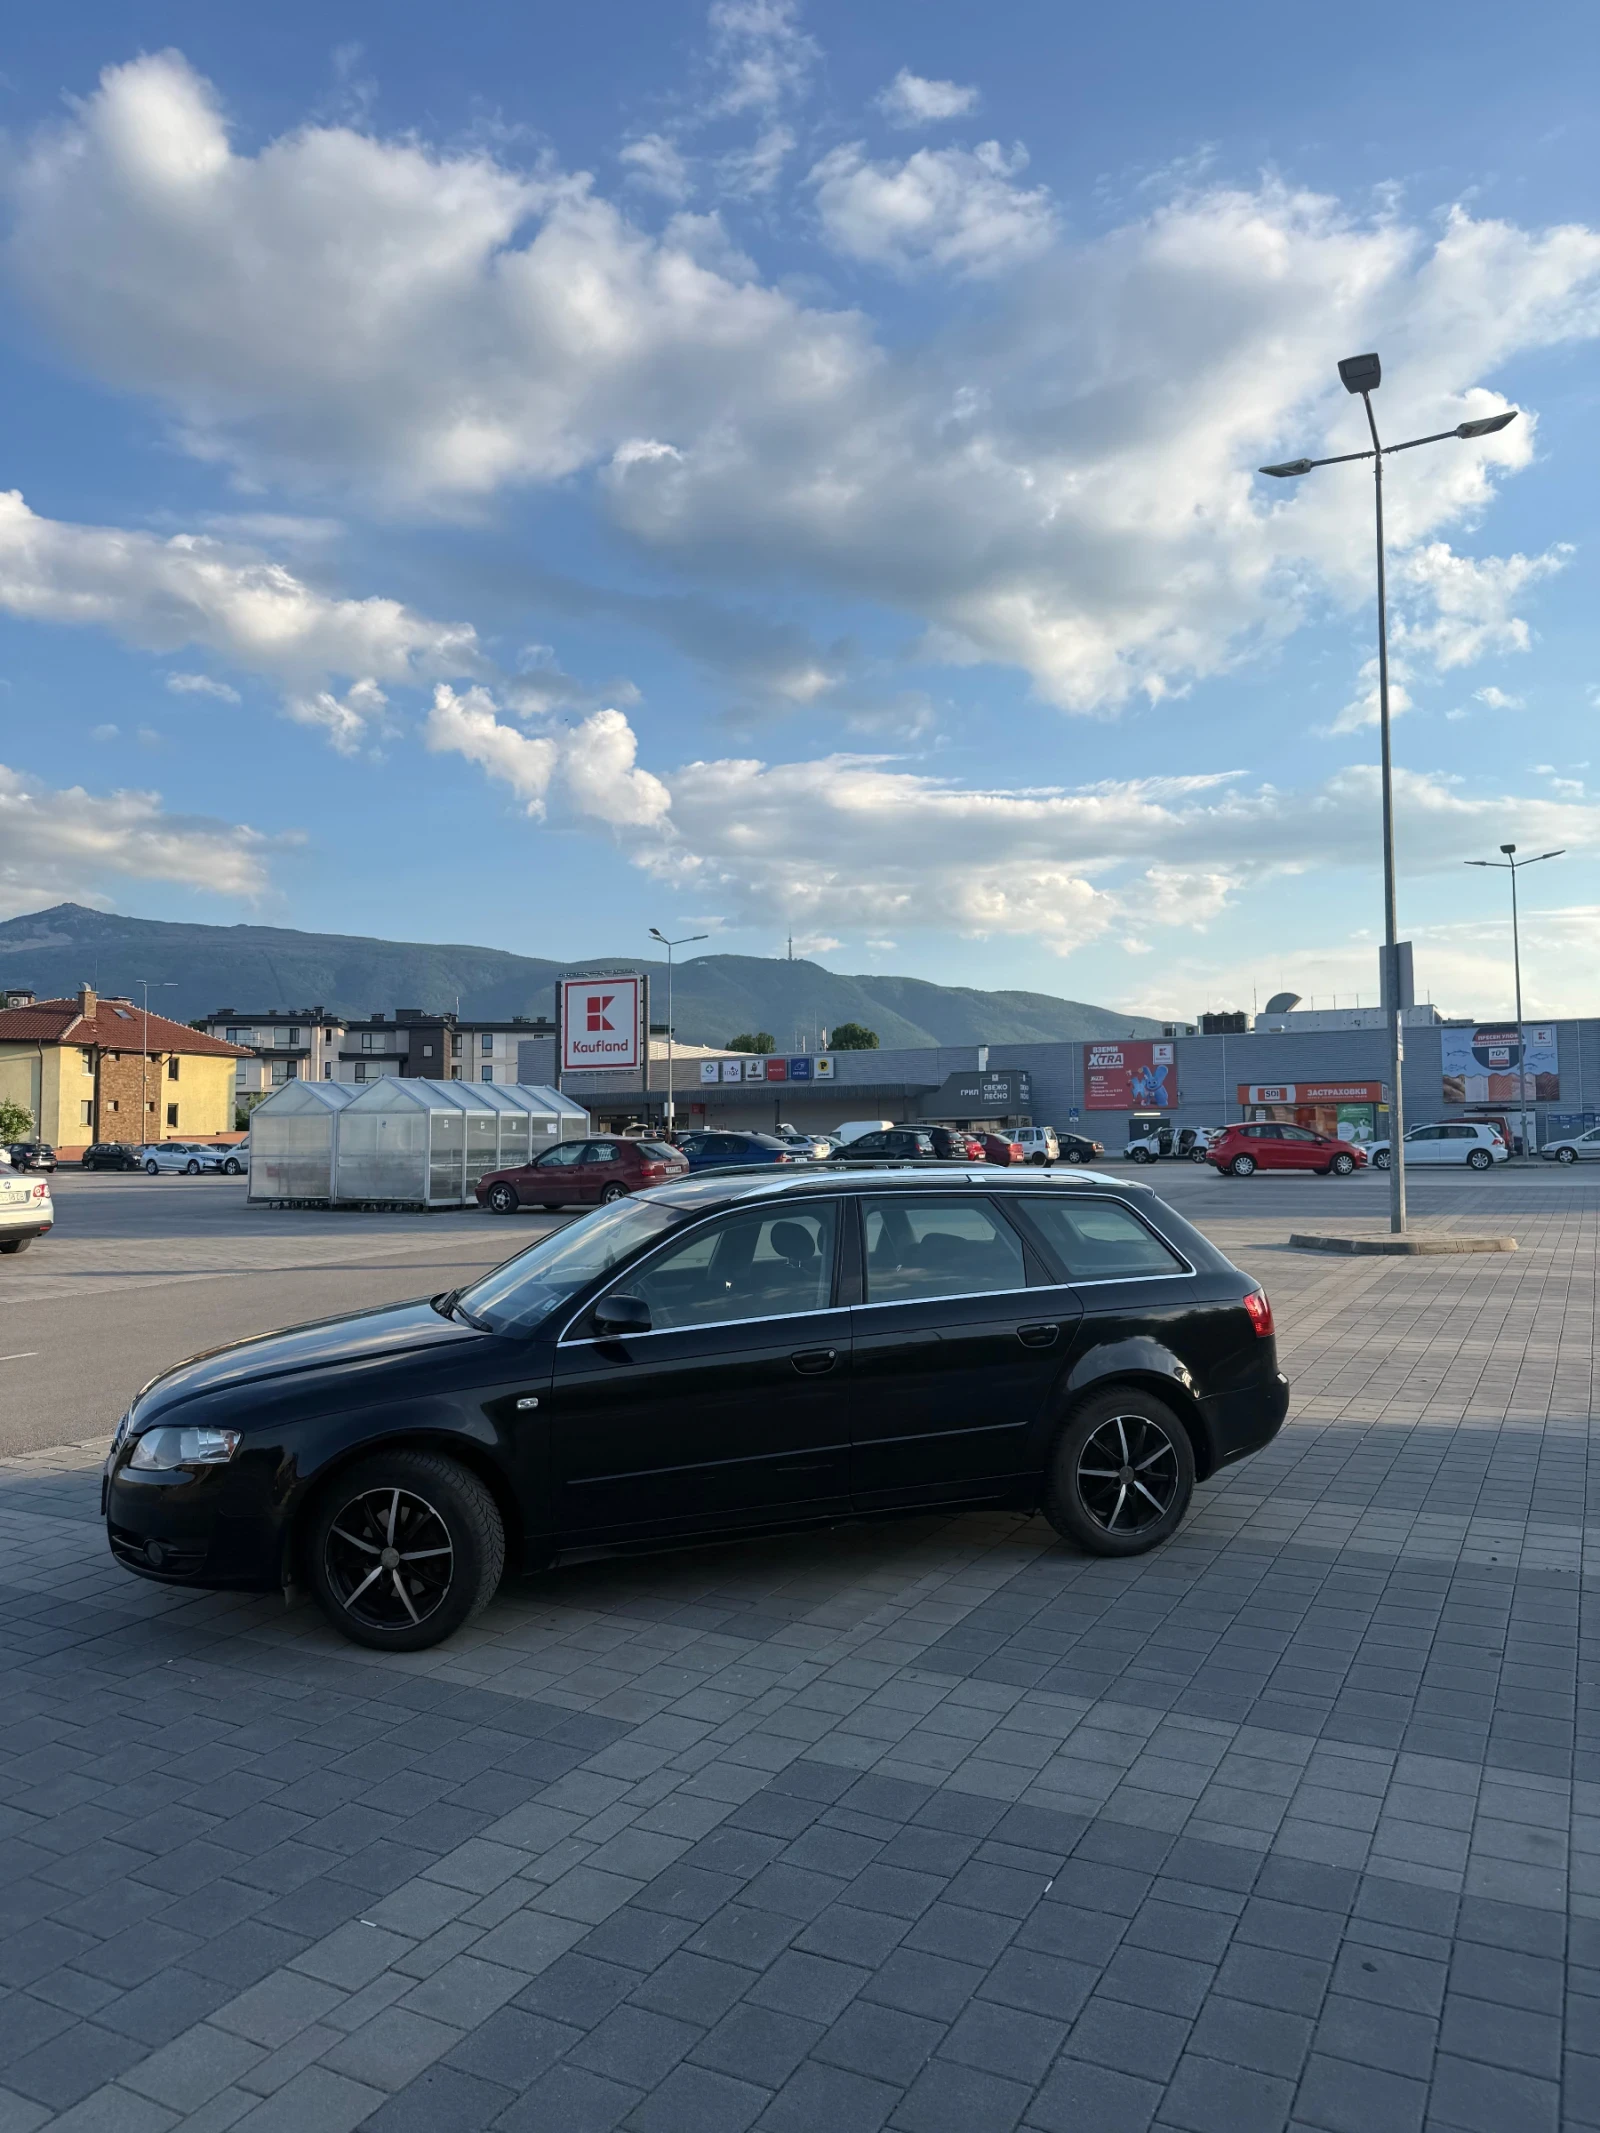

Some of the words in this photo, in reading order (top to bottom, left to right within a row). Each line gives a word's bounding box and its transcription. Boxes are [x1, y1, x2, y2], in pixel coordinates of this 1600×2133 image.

[587, 996, 616, 1031] K
[573, 1039, 629, 1053] Kaufland
[1491, 1049, 1507, 1057] TÜV
[1088, 1053, 1124, 1066] XTRA
[983, 1083, 1008, 1091] СВЕЖО
[983, 1092, 1008, 1100] ЛЕСНО
[1265, 1089, 1280, 1098] SDI
[1307, 1088, 1368, 1097] ЗАСТРАХОВКИ
